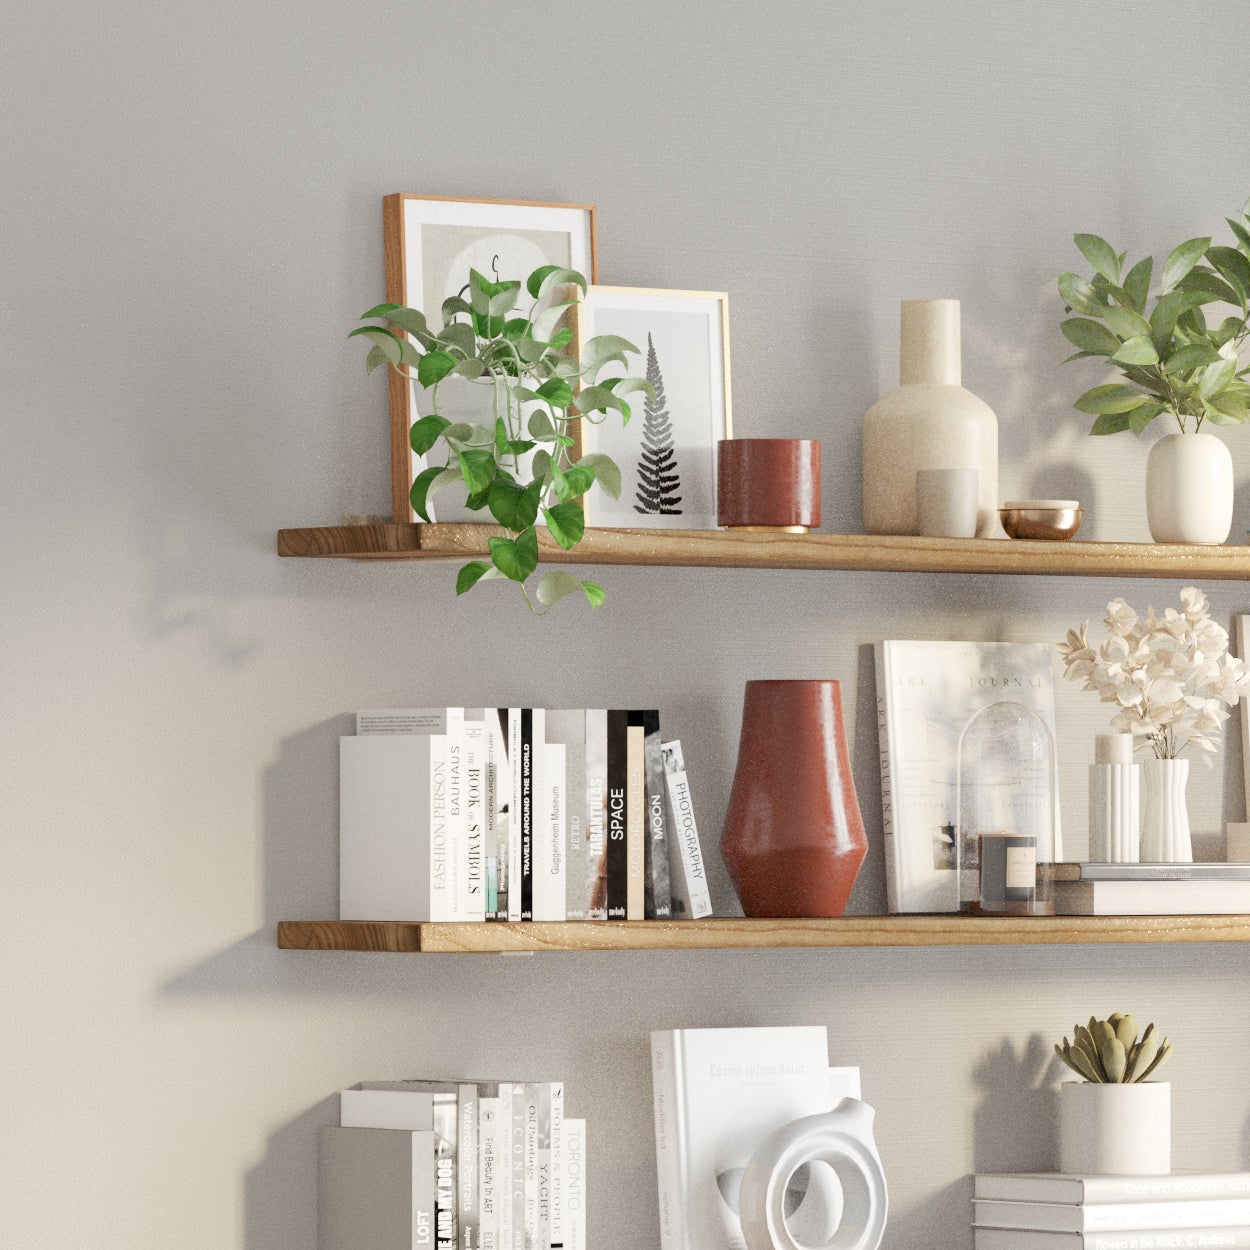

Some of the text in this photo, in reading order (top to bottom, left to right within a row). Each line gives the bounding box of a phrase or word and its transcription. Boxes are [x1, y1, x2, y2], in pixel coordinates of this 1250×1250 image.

[898, 676, 1044, 689] ARK JOURNAL
[450, 745, 461, 816] BAUHAUS
[467, 768, 480, 808] BOOK
[877, 696, 893, 836] ARK JOURNAL
[432, 761, 446, 891] FASHION PERSON
[550, 786, 561, 875] Guggenheim Museum
[570, 815, 581, 850] RETRO
[588, 778, 603, 857] TARANTULAS
[610, 787, 624, 841] SPACE
[629, 767, 641, 878] MOTORCYCLES
[650, 794, 664, 840] MOON
[676, 781, 704, 879] PHOTOGRAPHY
[467, 824, 480, 894] SYMBOLS
[463, 1102, 473, 1213] Watercolor Portraits
[513, 1115, 523, 1201] ICONIC
[526, 1105, 537, 1181] Oil Paintings
[553, 1107, 561, 1158] POEMS
[438, 1158, 452, 1186] DOG
[438, 1188, 452, 1211] MY
[483, 1137, 494, 1214] Find Beauty In ART
[540, 1163, 549, 1221] YACHT
[567, 1130, 581, 1211] TORONTO
[417, 1210, 429, 1245] LOFT
[438, 1212, 452, 1239] AND
[553, 1178, 561, 1235] PEOPLE
[483, 1231, 493, 1250] ELLE
[1095, 1238, 1128, 1250] Flowers
[1129, 1238, 1138, 1250] in
[1140, 1237, 1154, 1249] the
[1198, 1233, 1237, 1246] Andrews
